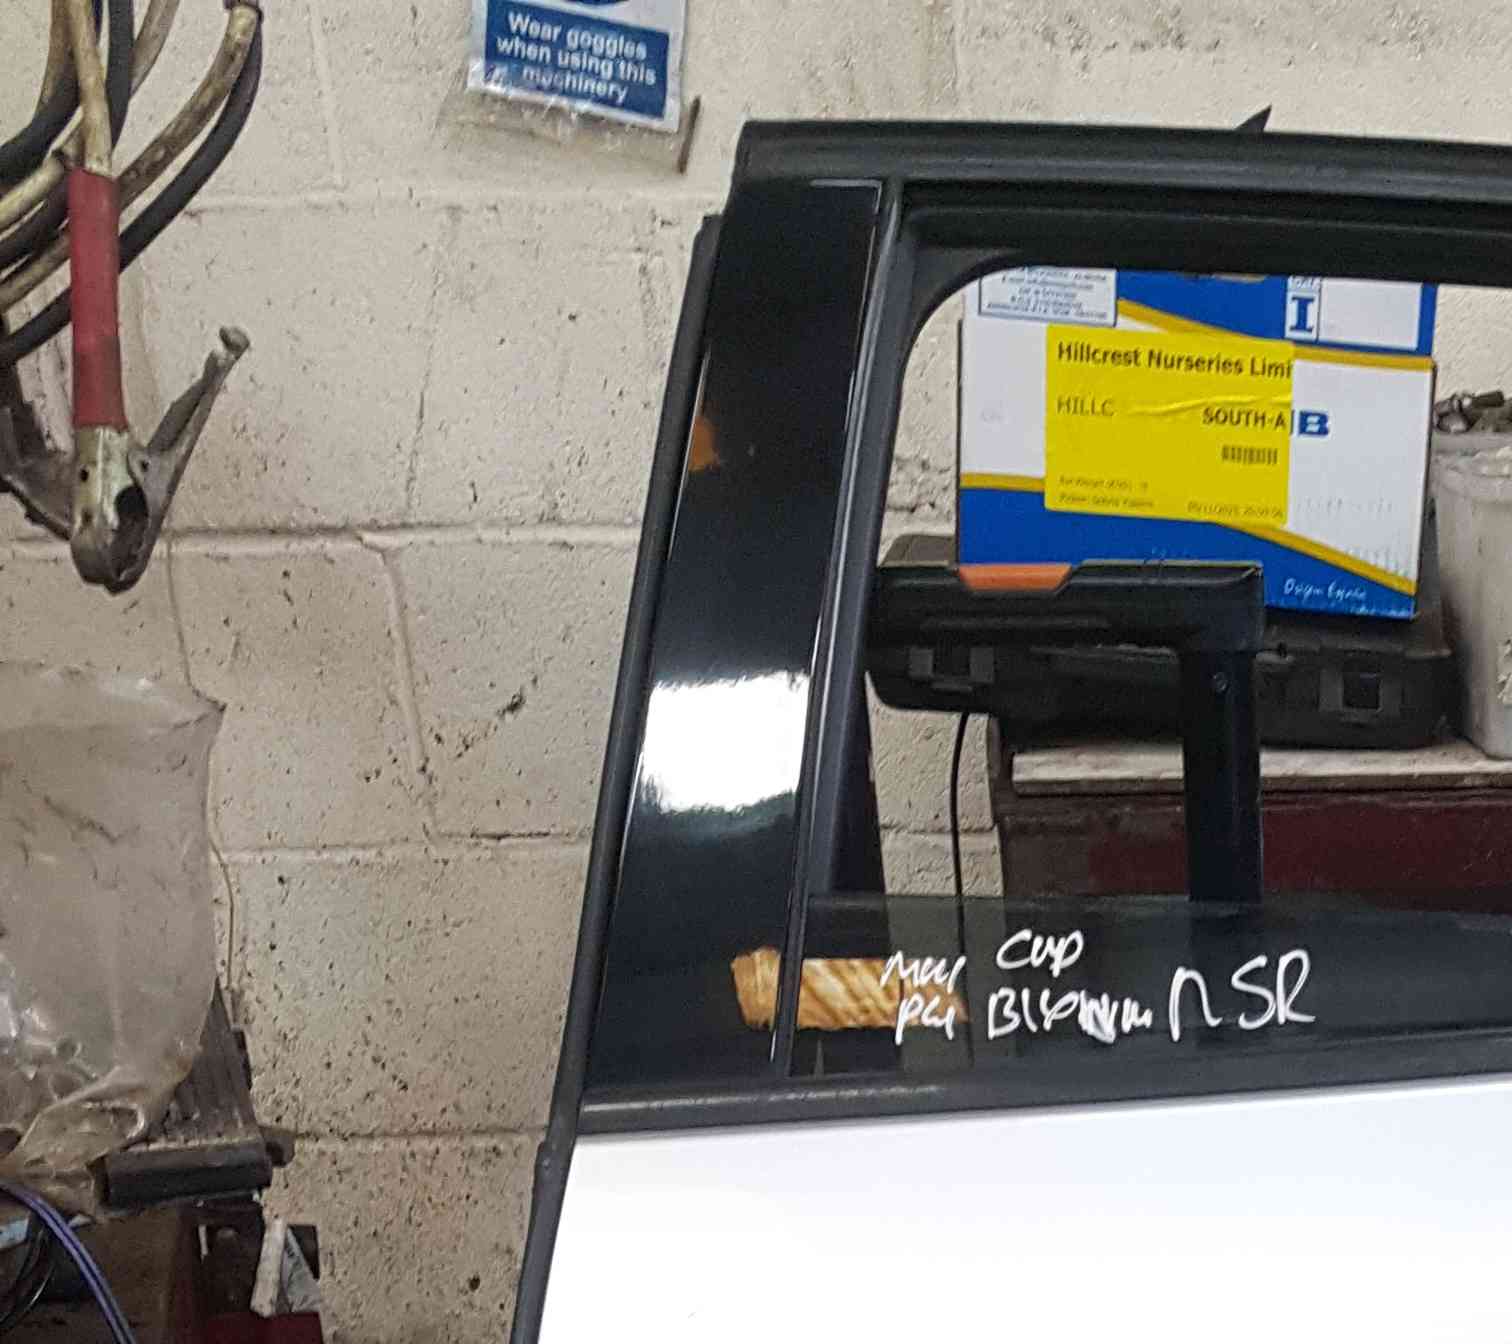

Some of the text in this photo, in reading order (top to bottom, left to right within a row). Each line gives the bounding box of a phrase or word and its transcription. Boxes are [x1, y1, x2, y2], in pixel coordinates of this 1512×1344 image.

[508, 12, 647, 60] Wear goggles
[496, 36, 657, 86] when using this
[522, 66, 628, 103] machinery
[1057, 341, 1141, 368] Hillcrest
[1147, 349, 1243, 376] Nurseries
